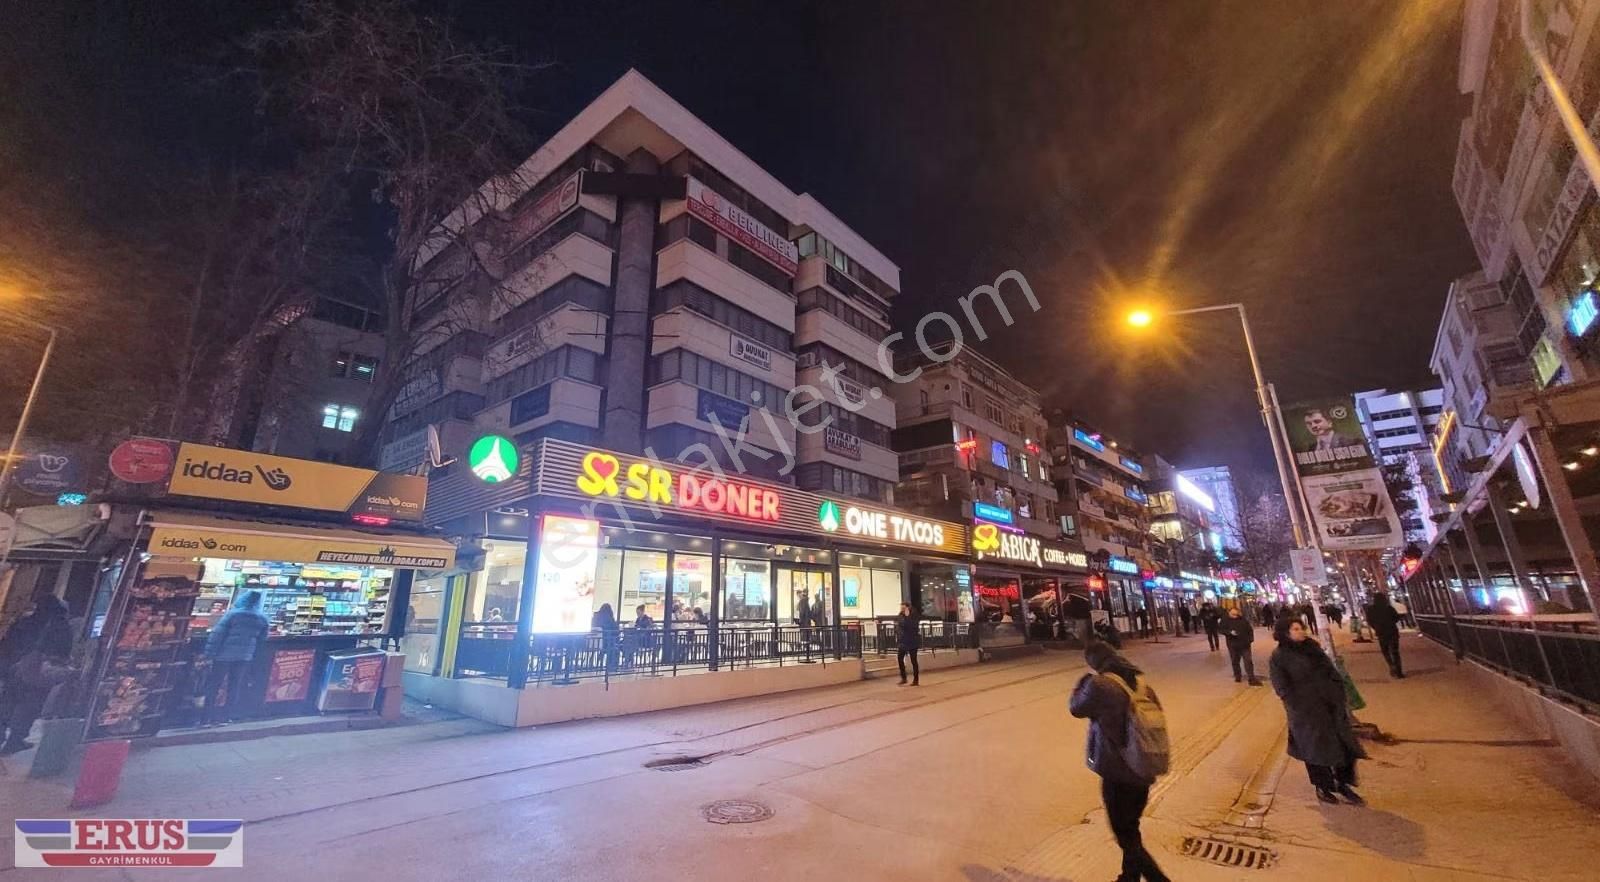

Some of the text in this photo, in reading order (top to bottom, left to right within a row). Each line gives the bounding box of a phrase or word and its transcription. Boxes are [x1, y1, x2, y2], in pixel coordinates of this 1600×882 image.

[727, 205, 793, 258] BERLINER
[182, 457, 253, 484] iddaa
[625, 463, 672, 505] SR
[161, 537, 247, 552] iddaa com
[845, 507, 944, 546] ONE TACOS
[978, 533, 1043, 568] ABICA
